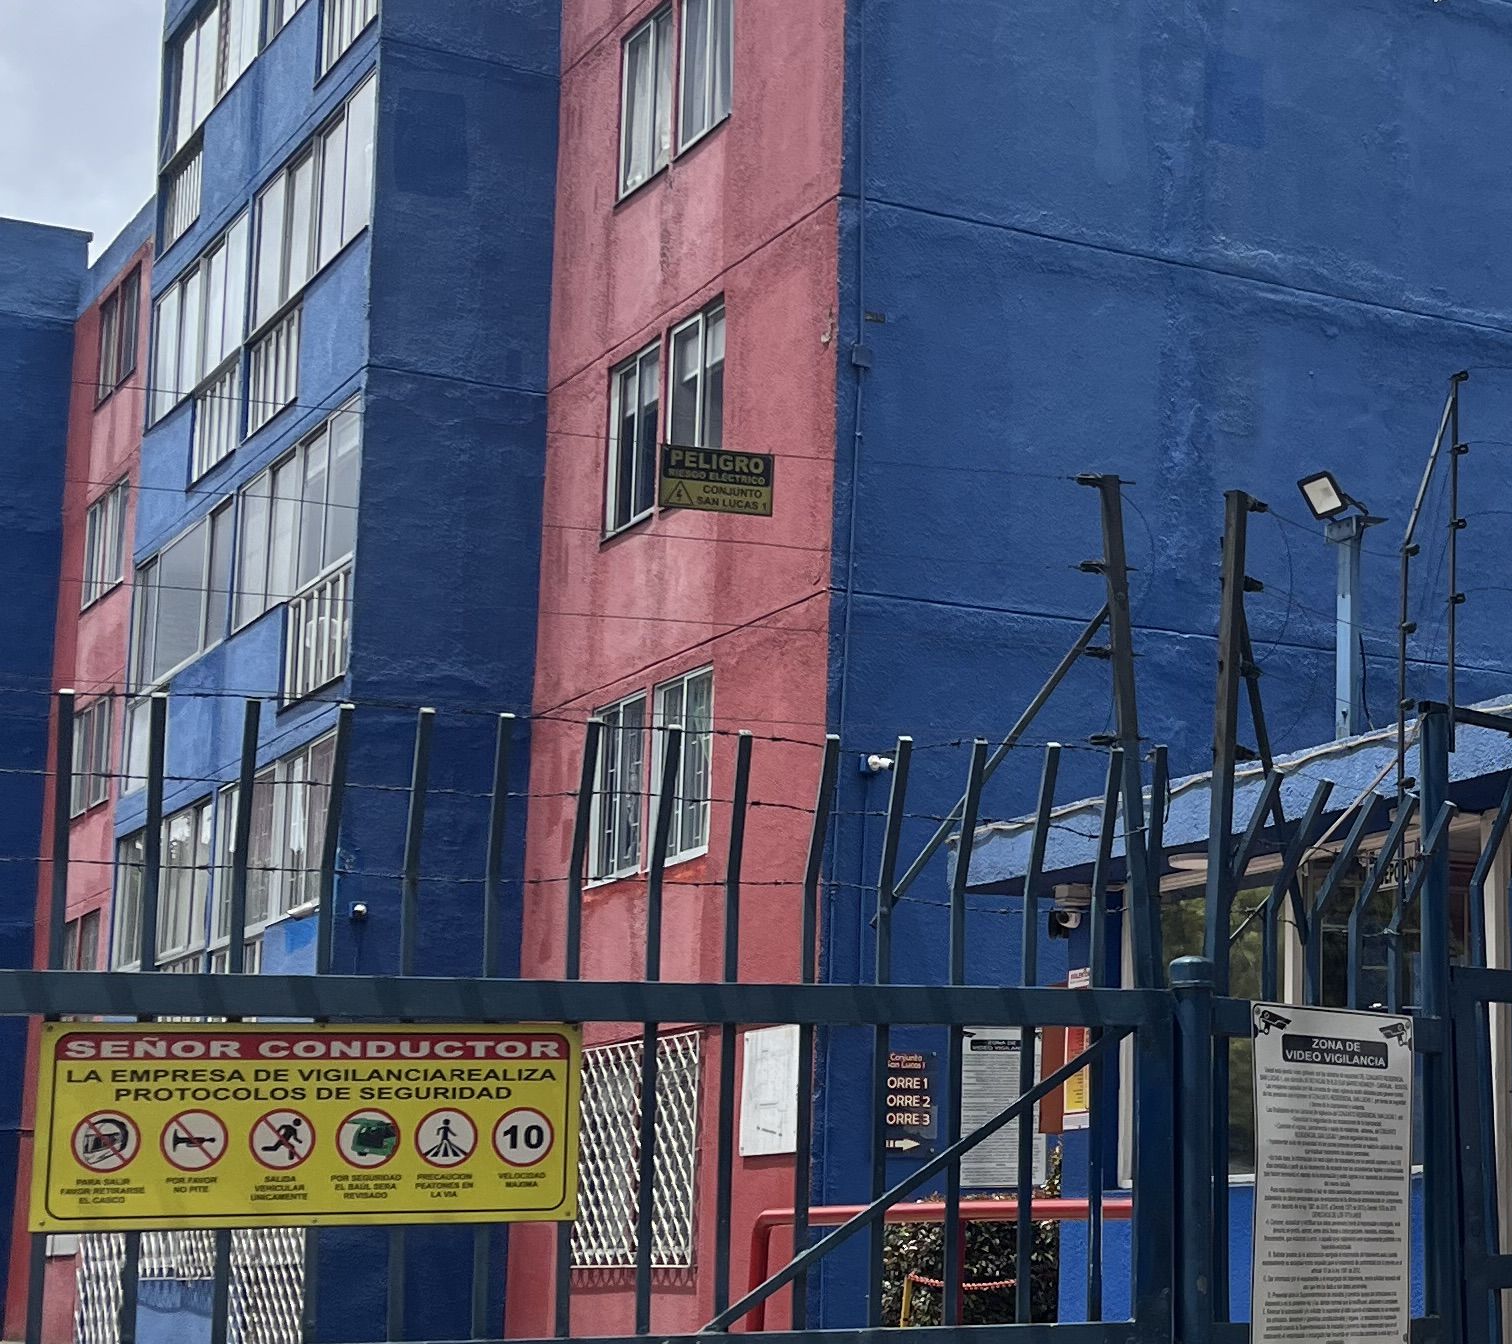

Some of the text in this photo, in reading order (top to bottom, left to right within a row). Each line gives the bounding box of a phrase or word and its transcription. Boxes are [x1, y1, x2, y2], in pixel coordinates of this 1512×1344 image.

[670, 449, 765, 475] PELIGRO
[668, 468, 707, 480] RIESGO
[703, 485, 763, 499] CONJUNTO
[697, 496, 720, 507] SAN
[723, 498, 758, 511] LUCAS
[65, 1037, 561, 1059] SEÑOR CONDUCTOR
[1311, 1038, 1361, 1053] ZONA DE
[1285, 1049, 1386, 1067] VIDEO VIGILANCIA
[66, 1069, 103, 1084] LA
[111, 1069, 247, 1083] EMPRESA
[254, 1069, 290, 1083] DE
[886, 1076, 928, 1089] ORRE 1
[114, 1086, 513, 1102] PROTOCOLOS DE SEGURIDAD
[886, 1094, 931, 1108] ORRE 2
[886, 1112, 931, 1126] ORRE 3
[503, 1124, 545, 1150] 10
[188, 1176, 218, 1184] FAVOR
[264, 1175, 297, 1183] SALIDA
[330, 1173, 402, 1182] POR SEGURIDAD
[498, 1171, 547, 1179] VELOCIDAD
[76, 1178, 101, 1186] PARA
[254, 1184, 305, 1192] VEHICULAR
[334, 1183, 345, 1191] EL
[461, 1181, 474, 1189] EN
[92, 1196, 126, 1204] CASCO
